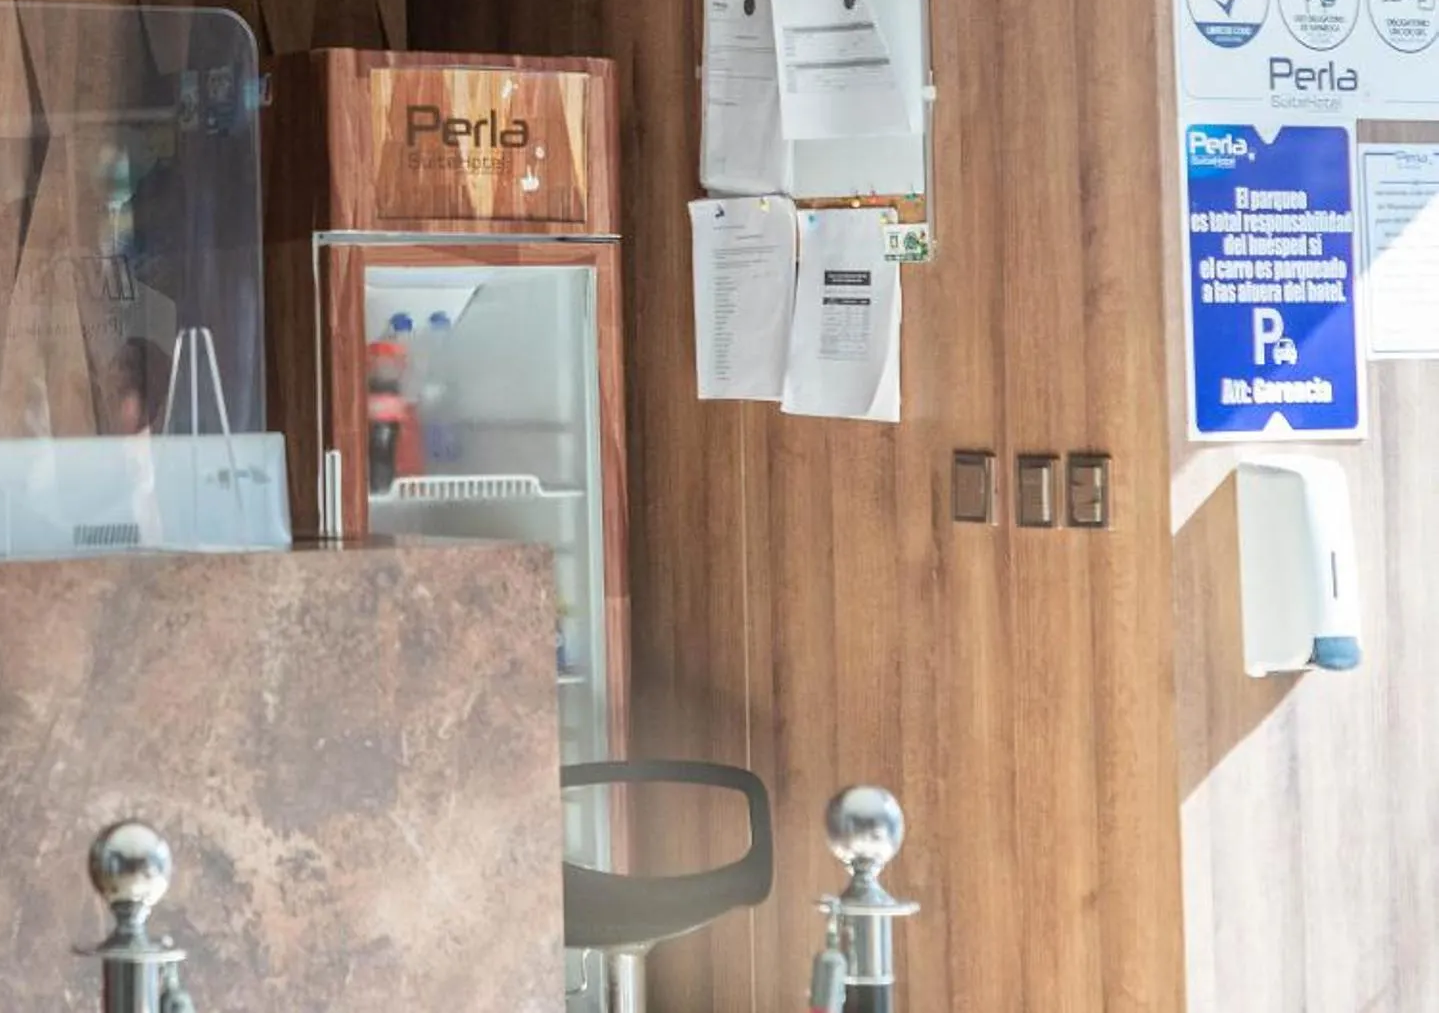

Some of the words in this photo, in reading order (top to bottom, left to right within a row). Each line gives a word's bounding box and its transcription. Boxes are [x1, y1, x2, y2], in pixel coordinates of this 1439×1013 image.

[1269, 57, 1358, 91] Perla
[406, 104, 530, 149] Perla
[1189, 132, 1248, 156] Perla
